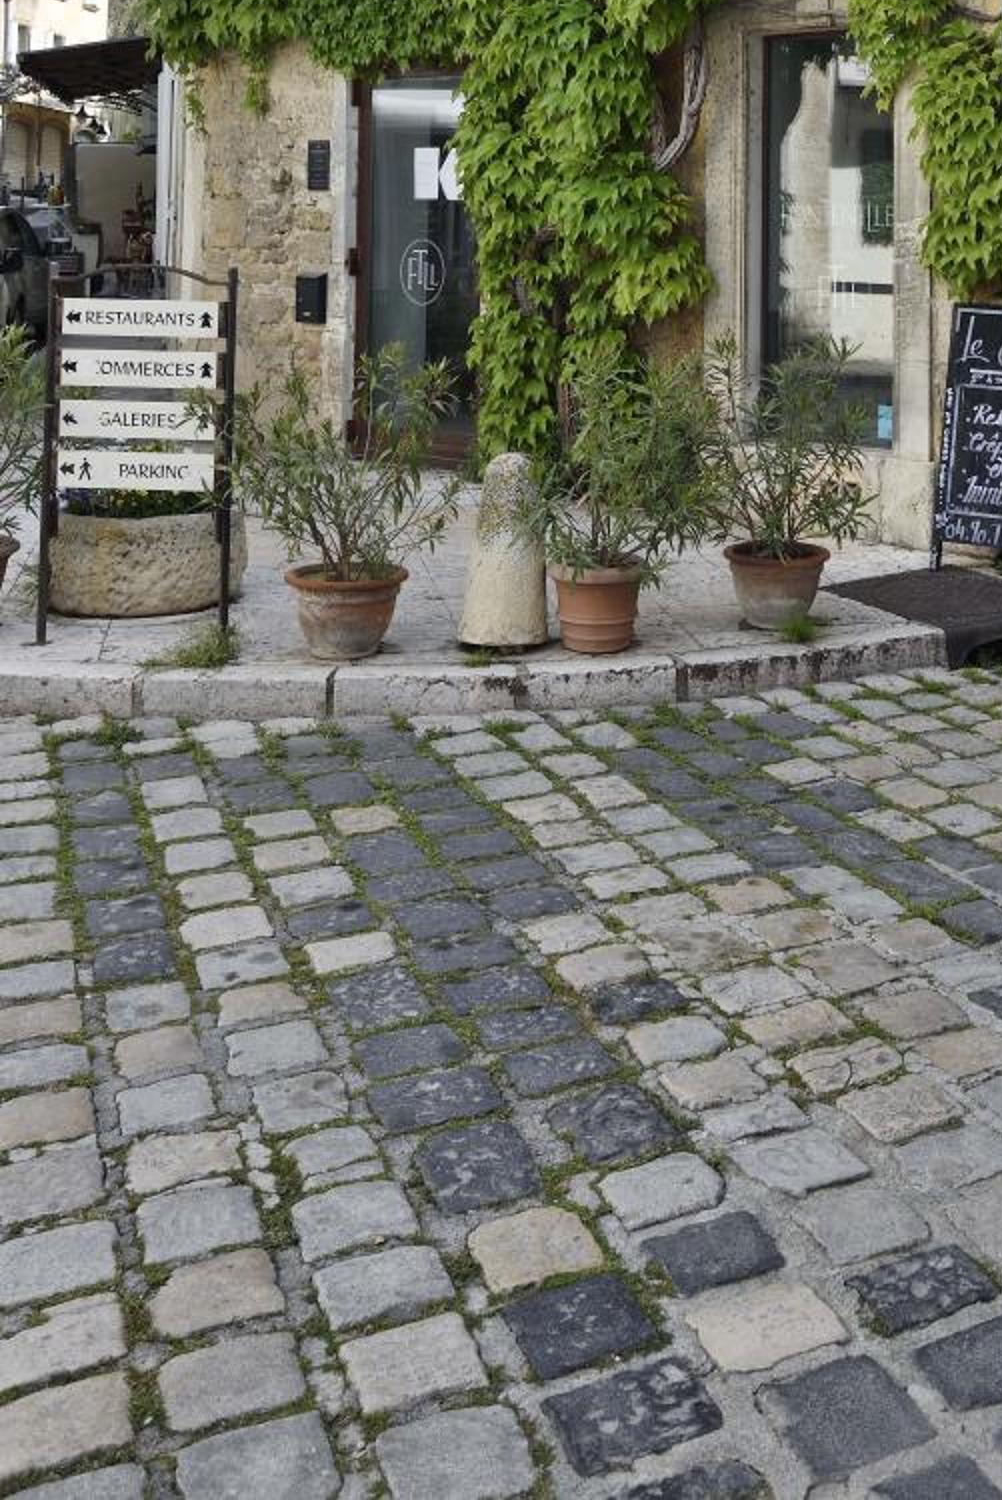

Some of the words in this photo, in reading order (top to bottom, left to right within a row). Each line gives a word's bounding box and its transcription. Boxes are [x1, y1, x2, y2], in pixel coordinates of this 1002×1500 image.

[85, 310, 195, 326] RESTAURANTS
[958, 315, 990, 362] Le
[100, 411, 177, 428] GALERIES
